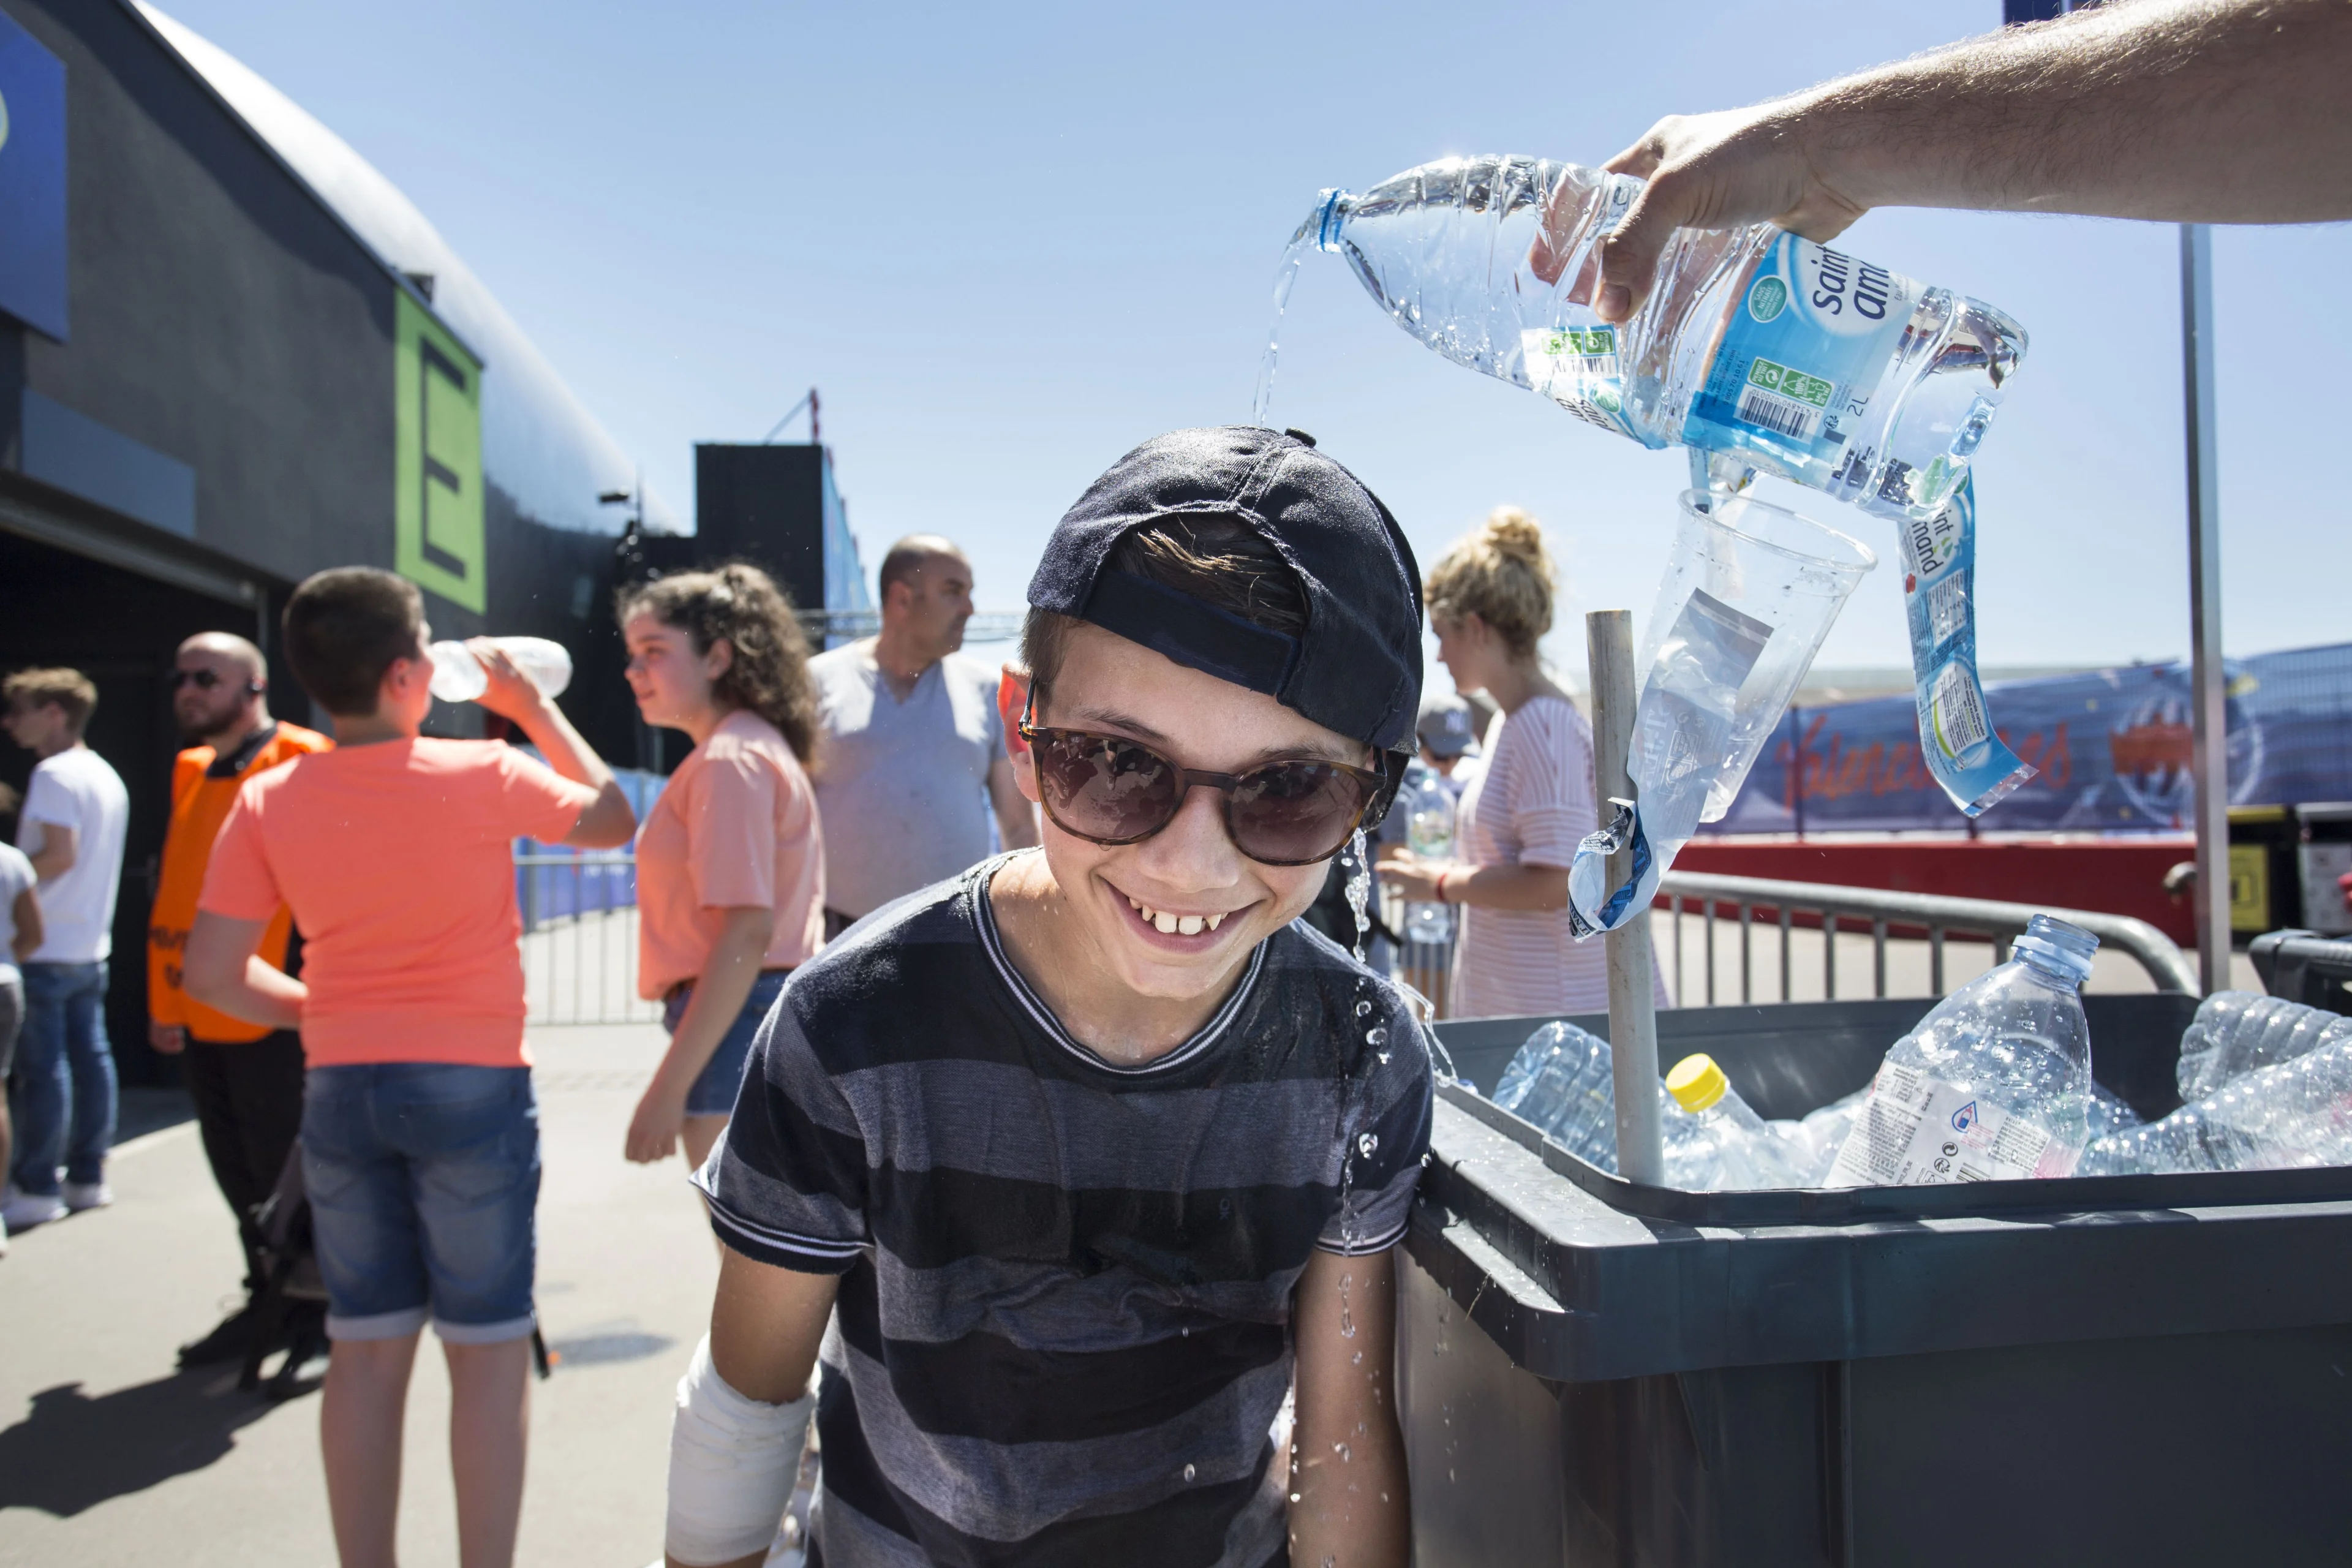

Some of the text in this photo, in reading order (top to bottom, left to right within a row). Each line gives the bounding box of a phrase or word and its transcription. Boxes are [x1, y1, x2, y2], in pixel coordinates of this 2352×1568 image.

[1811, 244, 1849, 315] saint
[1754, 285, 1765, 301] SANS
[1733, 368, 1741, 378] 10
[1736, 358, 1745, 369] 61
[1751, 360, 1764, 383] PENSEZ
[1728, 378, 1737, 388] 70
[1795, 375, 1806, 396] 100%
[1751, 388, 1779, 404] 020010
[1847, 397, 1869, 417] 2L
[420, 336, 467, 580] E
[1912, 521, 1944, 576] mand
